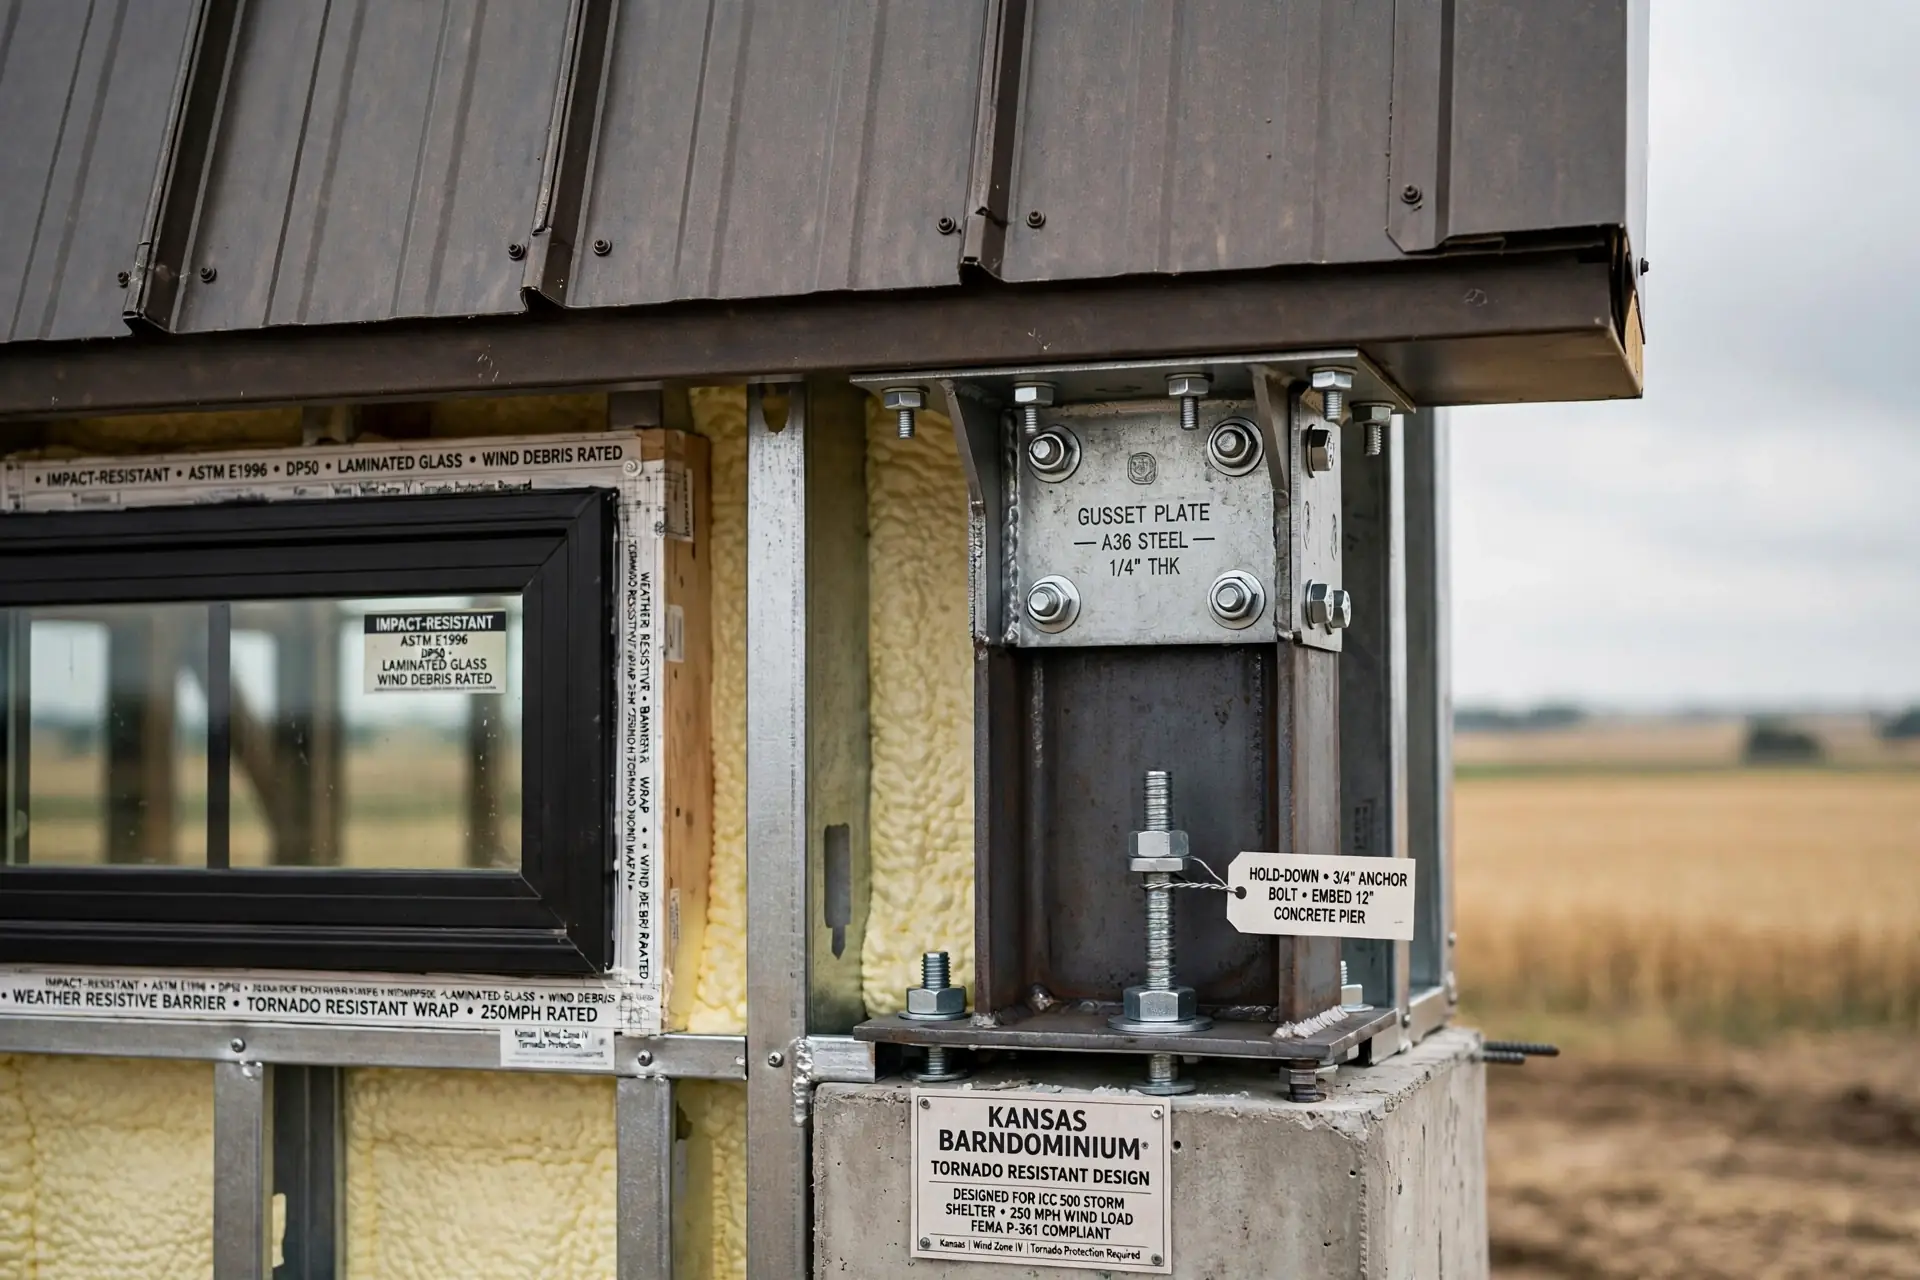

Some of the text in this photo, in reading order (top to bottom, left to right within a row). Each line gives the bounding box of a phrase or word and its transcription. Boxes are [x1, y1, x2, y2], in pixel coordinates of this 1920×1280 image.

[47, 445, 623, 487] IMPACT-RESISTANT ASTM E1996 DP50 LAMINATED GLASS WIND DEBRIS RATED
[1077, 503, 1211, 526] GUSSET PLATE
[1101, 531, 1189, 551] A36 STEEL
[1109, 557, 1181, 577] 1/4" THK
[376, 615, 494, 631] IMPACT-RESISTANT
[400, 634, 468, 647] ASTM E1996
[382, 658, 487, 672] LAMINATED GLASS
[377, 672, 493, 686] WIND DEBRIS RATED
[639, 775, 650, 814] WRAP
[1249, 866, 1408, 887] HOLD-DOWN 3/4" ANCHOR
[1268, 887, 1374, 905] BOLT EMBED 12"
[1273, 906, 1366, 924] CONCRETE PIER
[13, 988, 598, 1023] WEATHER RESISTIVE BARRIER TORNADO RESISTANT WRAP 250MPH RATED
[504, 990, 535, 1002] GLASS
[548, 992, 575, 1003] WIND
[577, 993, 616, 1004] DEBRIS
[988, 1105, 1087, 1132] KANSAS
[939, 1129, 1140, 1160] BARNDOMINIUM
[931, 1160, 1150, 1186] TORNADO RESISTANT DESIGN
[953, 1188, 1125, 1210] DESIGNED FOR ICC 500 STORM
[945, 1203, 1134, 1226] SHELTER 250 MPH WIND LOAD
[971, 1219, 1112, 1240] FEMA P-361 COMPLIANT
[939, 1238, 1140, 1261] Kansas Wind Zone IV Tornado Protection Required
